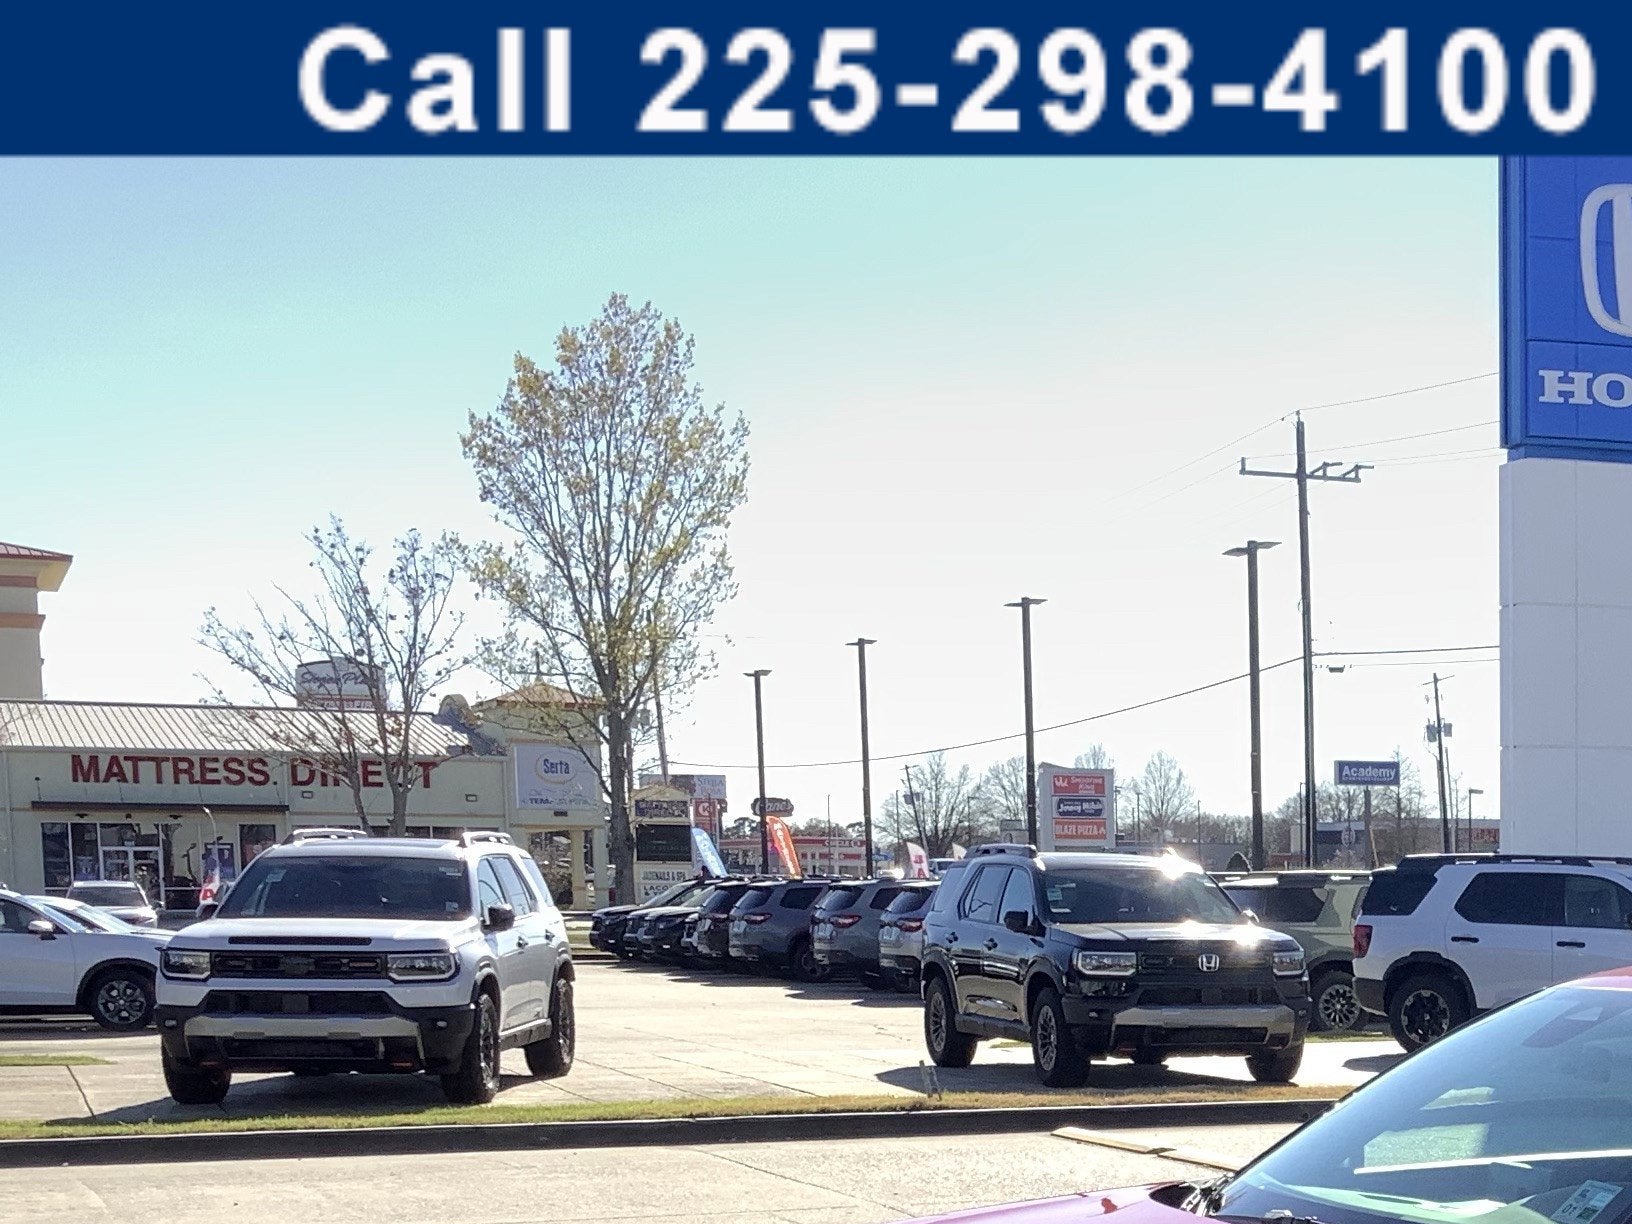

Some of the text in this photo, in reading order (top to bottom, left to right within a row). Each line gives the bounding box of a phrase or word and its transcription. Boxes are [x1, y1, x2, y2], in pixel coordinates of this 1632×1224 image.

[71, 754, 270, 786] MATTRESS
[543, 758, 570, 774] Serta
[1342, 765, 1396, 780] Academy
